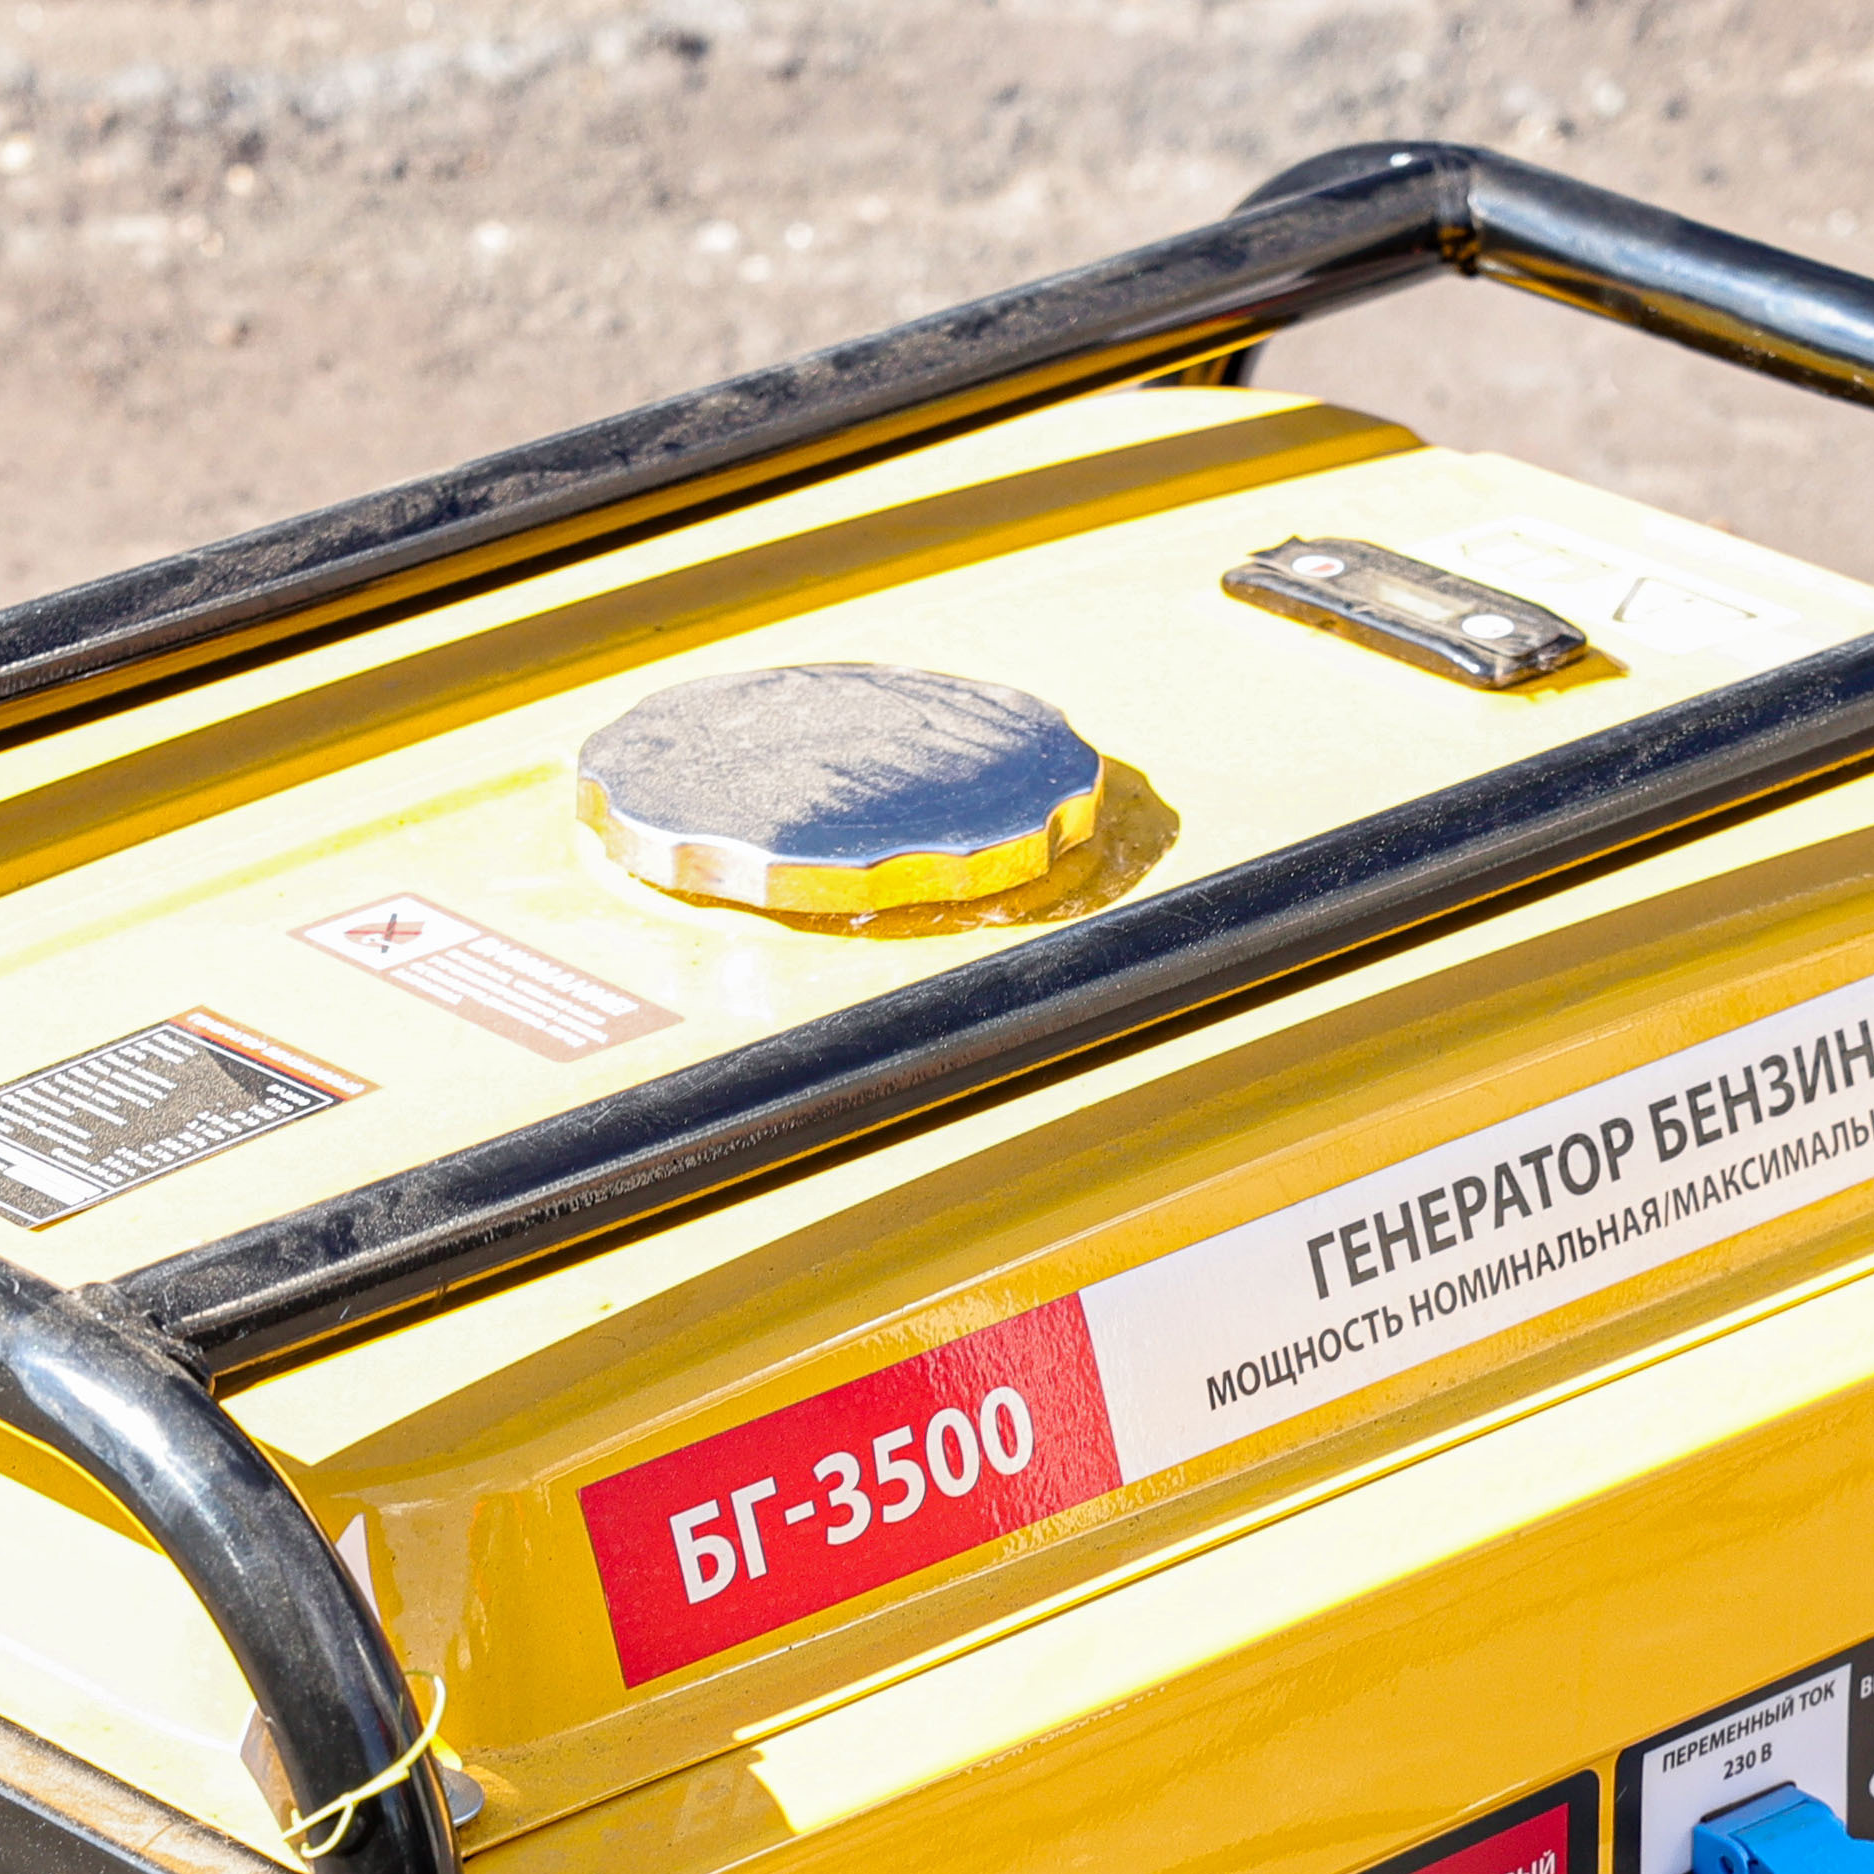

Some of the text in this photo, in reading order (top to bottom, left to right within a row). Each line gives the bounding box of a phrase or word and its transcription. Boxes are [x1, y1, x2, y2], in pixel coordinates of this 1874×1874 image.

[1307, 1117, 1634, 1300] ГЕНЕРАТОР
[1207, 1304, 1404, 1410] МОЩНОСТЬ
[668, 1383, 1034, 1605] БГ-3500
[1662, 1679, 1836, 1773] ПЕРЕМЕННЫЙ ТОК
[1723, 1742, 1773, 1780] 230 В
